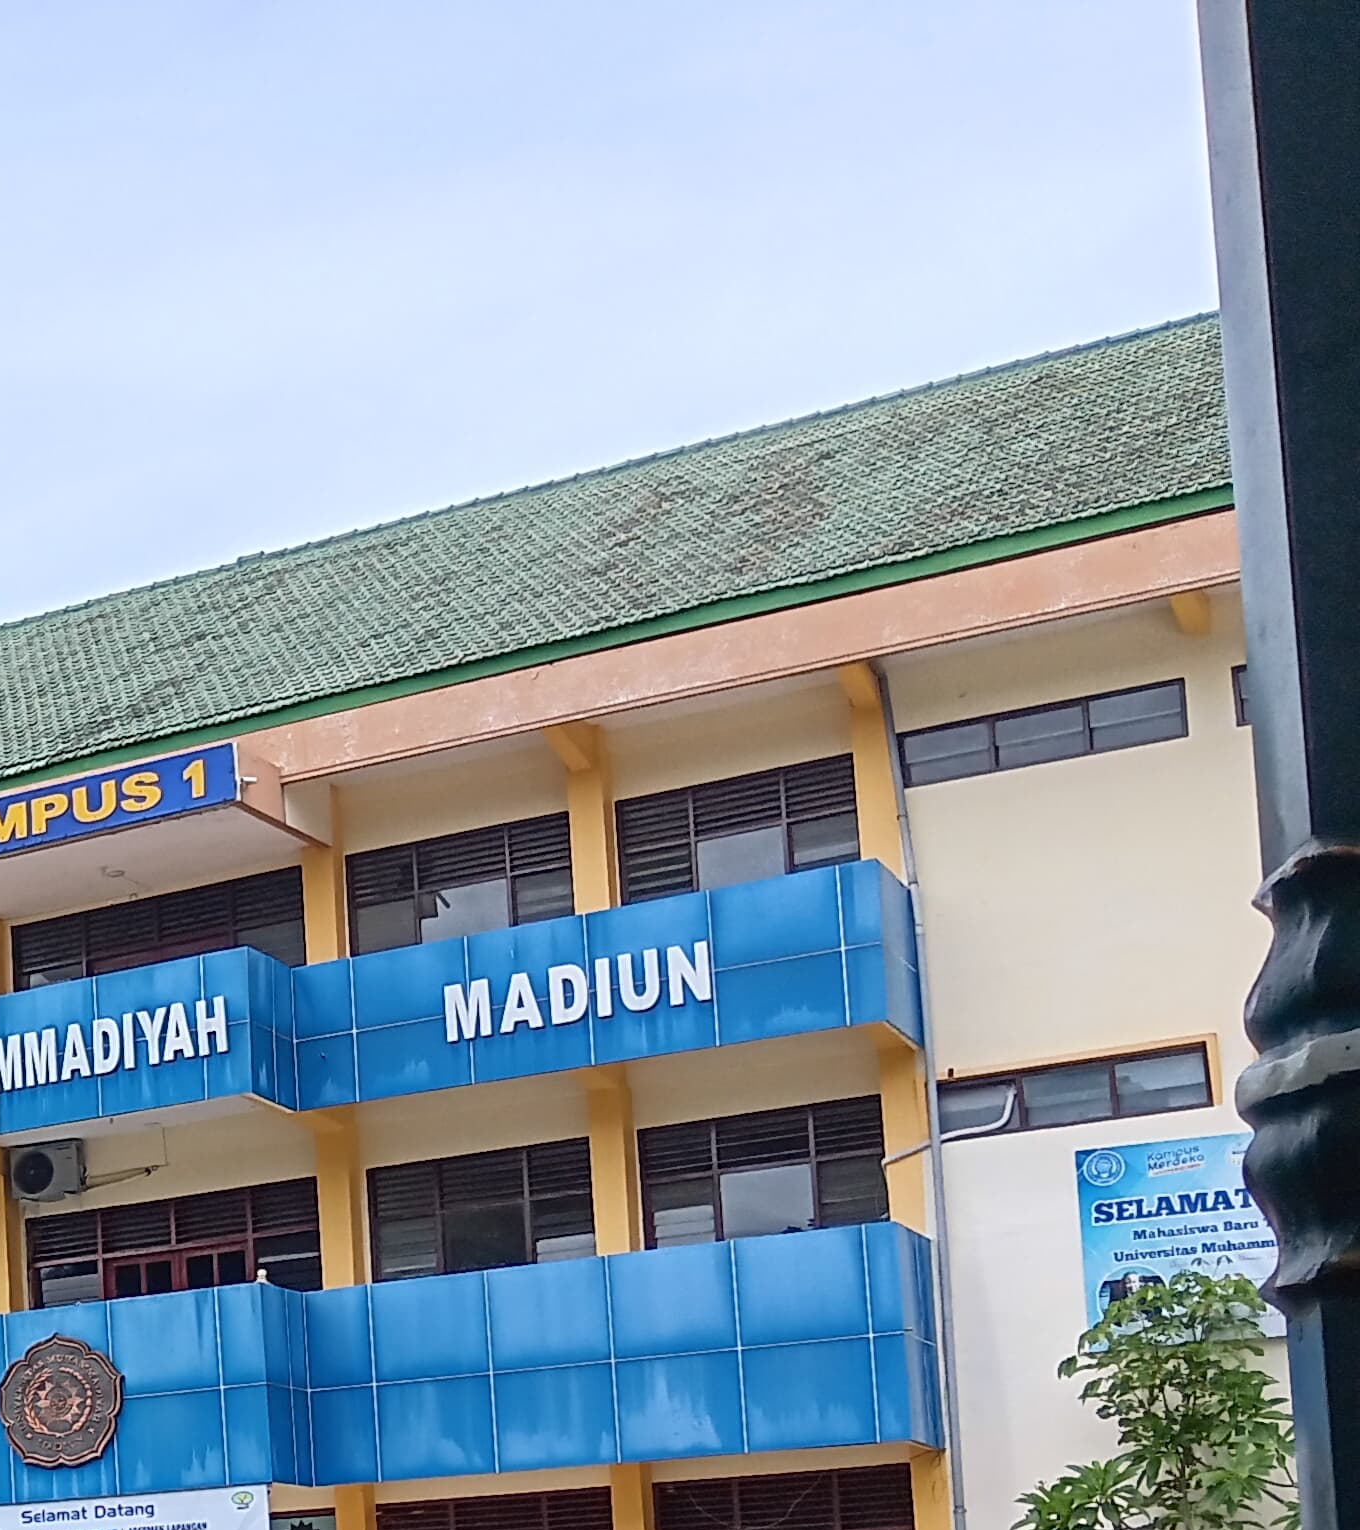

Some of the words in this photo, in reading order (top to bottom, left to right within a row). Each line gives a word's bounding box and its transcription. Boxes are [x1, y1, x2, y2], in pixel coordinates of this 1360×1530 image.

[182, 758, 207, 799] 1
[443, 941, 713, 1043] MADIUN
[1093, 1188, 1253, 1224] SELAMAT
[1132, 1224, 1219, 1241] Mahasiswa
[1223, 1220, 1259, 1232] Baru
[1113, 1245, 1198, 1263] Universitas
[1201, 1239, 1276, 1254] Muhamm
[21, 1506, 88, 1525] Selamat
[94, 1502, 155, 1519] Datang
